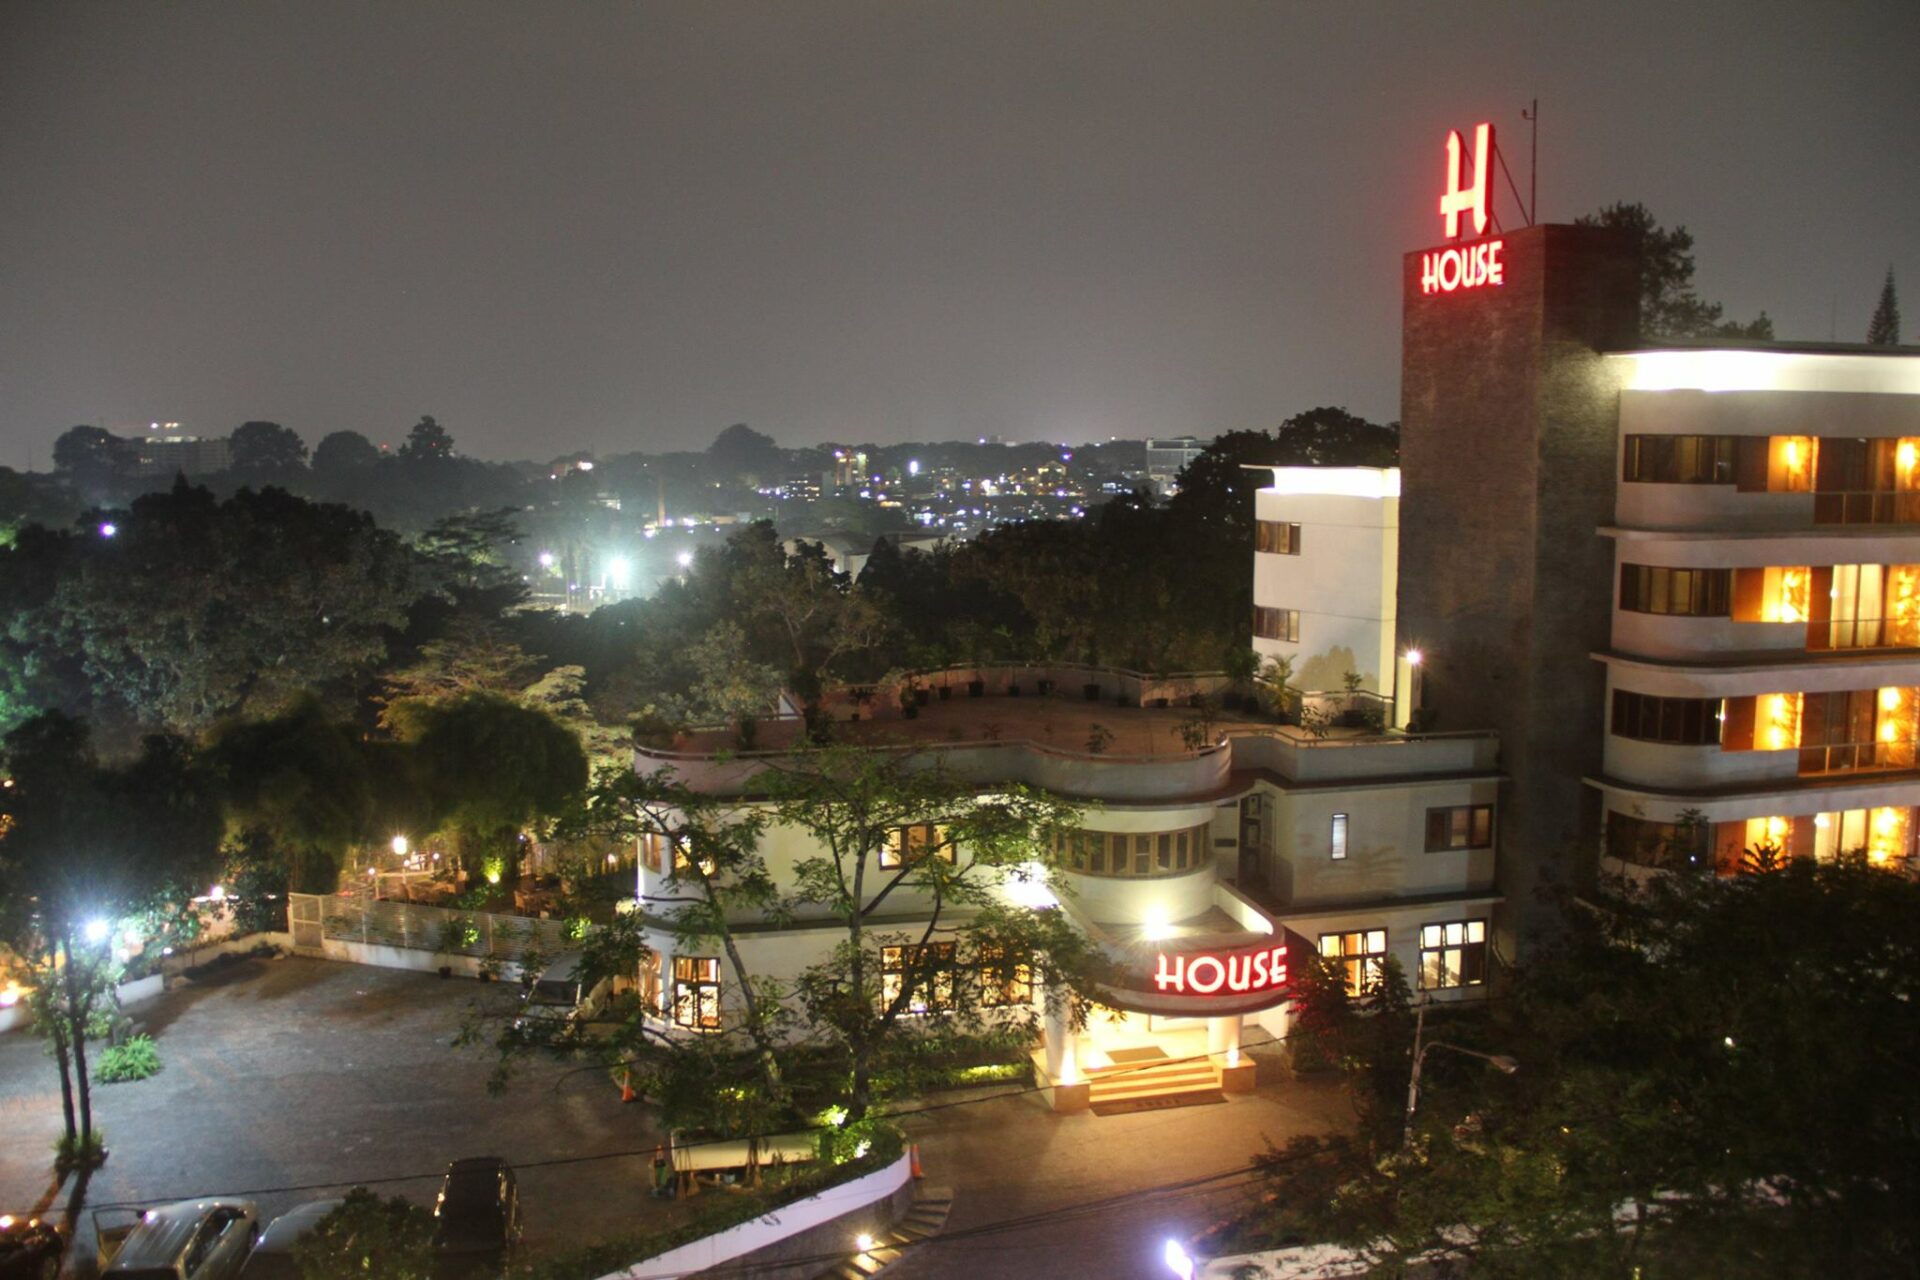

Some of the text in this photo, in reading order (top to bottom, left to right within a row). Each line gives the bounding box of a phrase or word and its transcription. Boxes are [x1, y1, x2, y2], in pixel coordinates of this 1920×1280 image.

[1440, 122, 1494, 238] H
[1421, 240, 1503, 294] HOUSE
[1154, 946, 1287, 993] HOUSE
